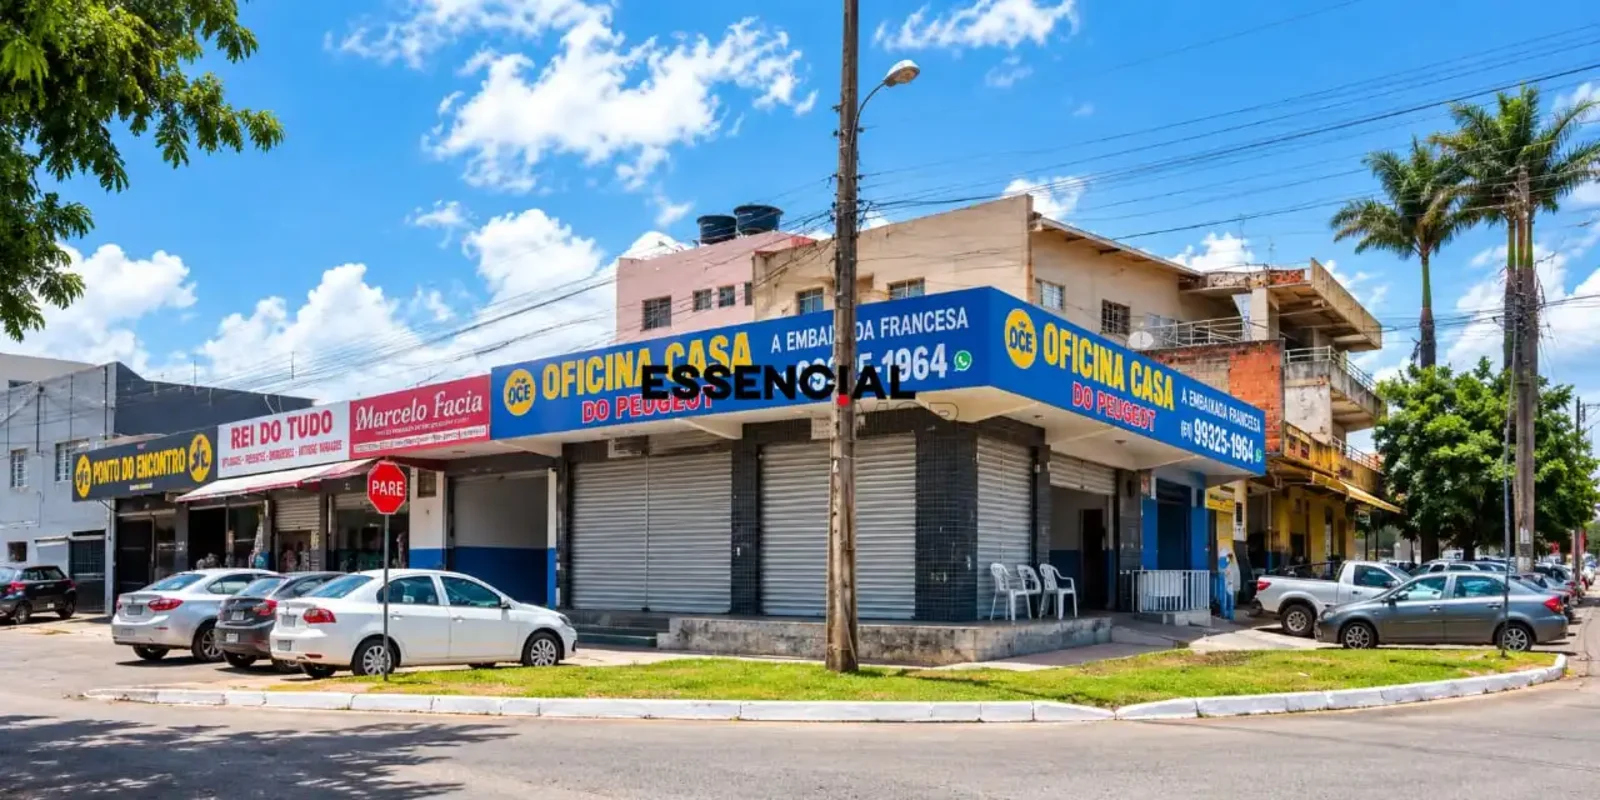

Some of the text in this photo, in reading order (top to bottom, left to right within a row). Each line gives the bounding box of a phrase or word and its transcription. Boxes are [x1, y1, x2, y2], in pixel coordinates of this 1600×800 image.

[771, 333, 782, 354] A
[880, 306, 969, 338] FRANCESA
[542, 348, 653, 400] OFICINA
[664, 332, 753, 383] CASA
[1043, 322, 1175, 411] OFICINA CASA
[355, 397, 427, 431] Marcelo
[433, 390, 483, 419] Facia
[582, 399, 610, 424] DO
[1072, 381, 1156, 432] DO PEUGEOT
[1181, 386, 1188, 405] A
[231, 425, 254, 449] REI
[260, 420, 281, 445] DO
[287, 409, 333, 440] TUDO
[1194, 417, 1253, 464] 99325-1964
[92, 458, 120, 485] PONTO
[122, 455, 135, 480] DO
[136, 447, 186, 479] ENCONTRO
[372, 480, 404, 497] PARE
